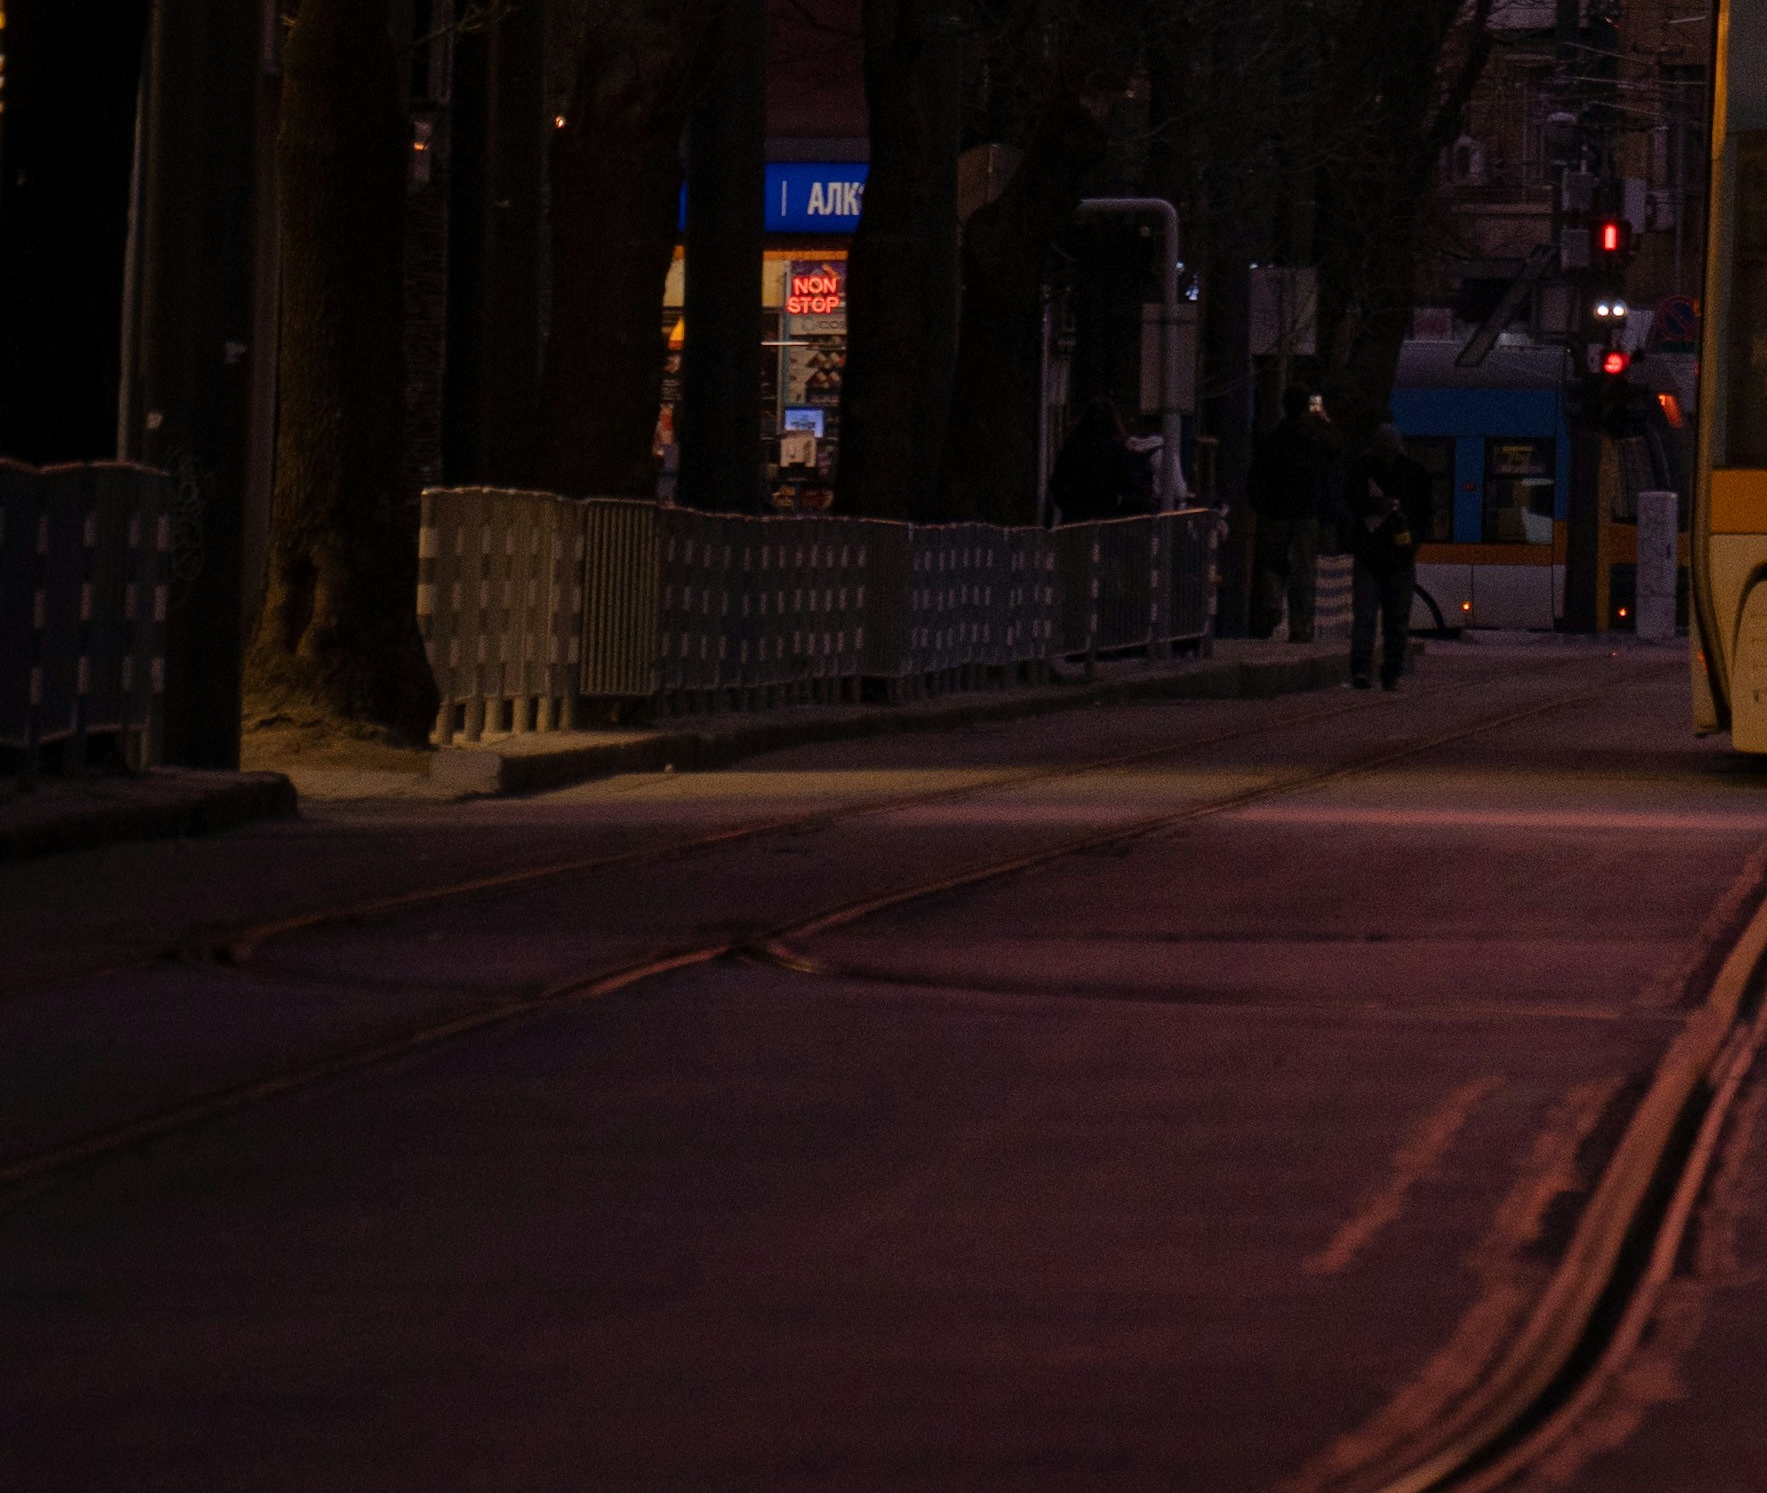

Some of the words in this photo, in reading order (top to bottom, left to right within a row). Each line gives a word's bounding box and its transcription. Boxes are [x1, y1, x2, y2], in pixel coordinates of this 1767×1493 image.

[807, 182, 865, 215] АЛК
[792, 276, 837, 295] NON
[786, 296, 840, 315] STOP
